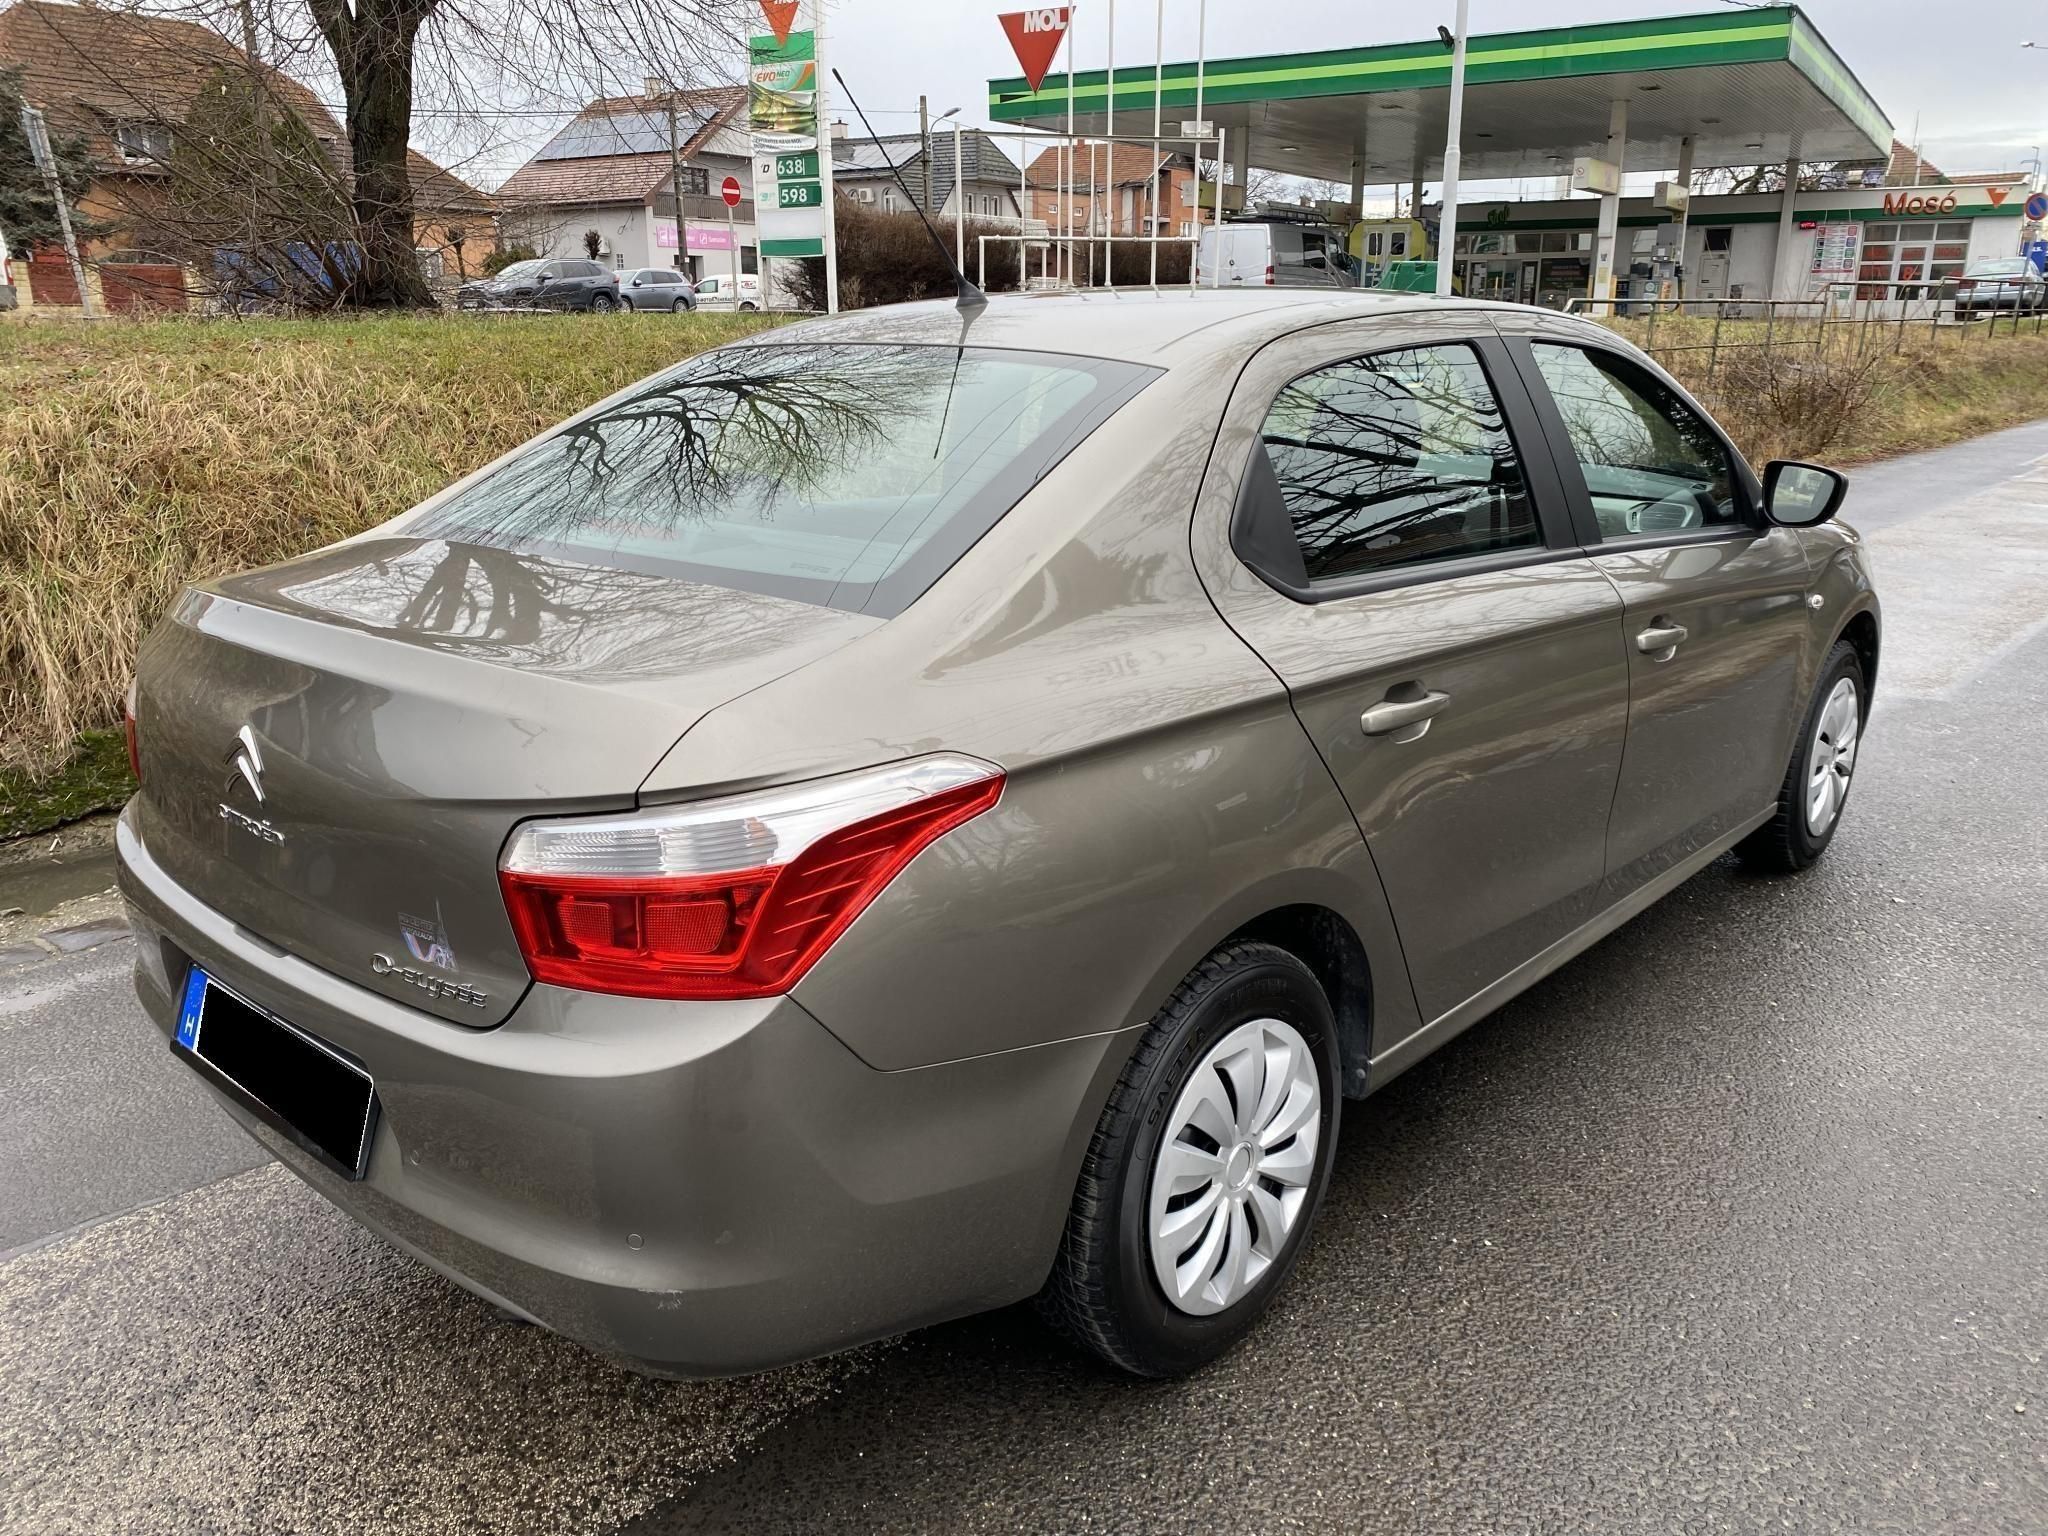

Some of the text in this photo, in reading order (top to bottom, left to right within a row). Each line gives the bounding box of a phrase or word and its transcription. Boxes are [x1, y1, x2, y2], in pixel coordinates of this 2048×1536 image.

[1023, 9, 1067, 33] MOL
[756, 71, 775, 82] EVO
[777, 159, 803, 174] 638
[781, 188, 807, 203] 598
[1883, 190, 1957, 216] Mosó
[184, 1014, 195, 1037] H
